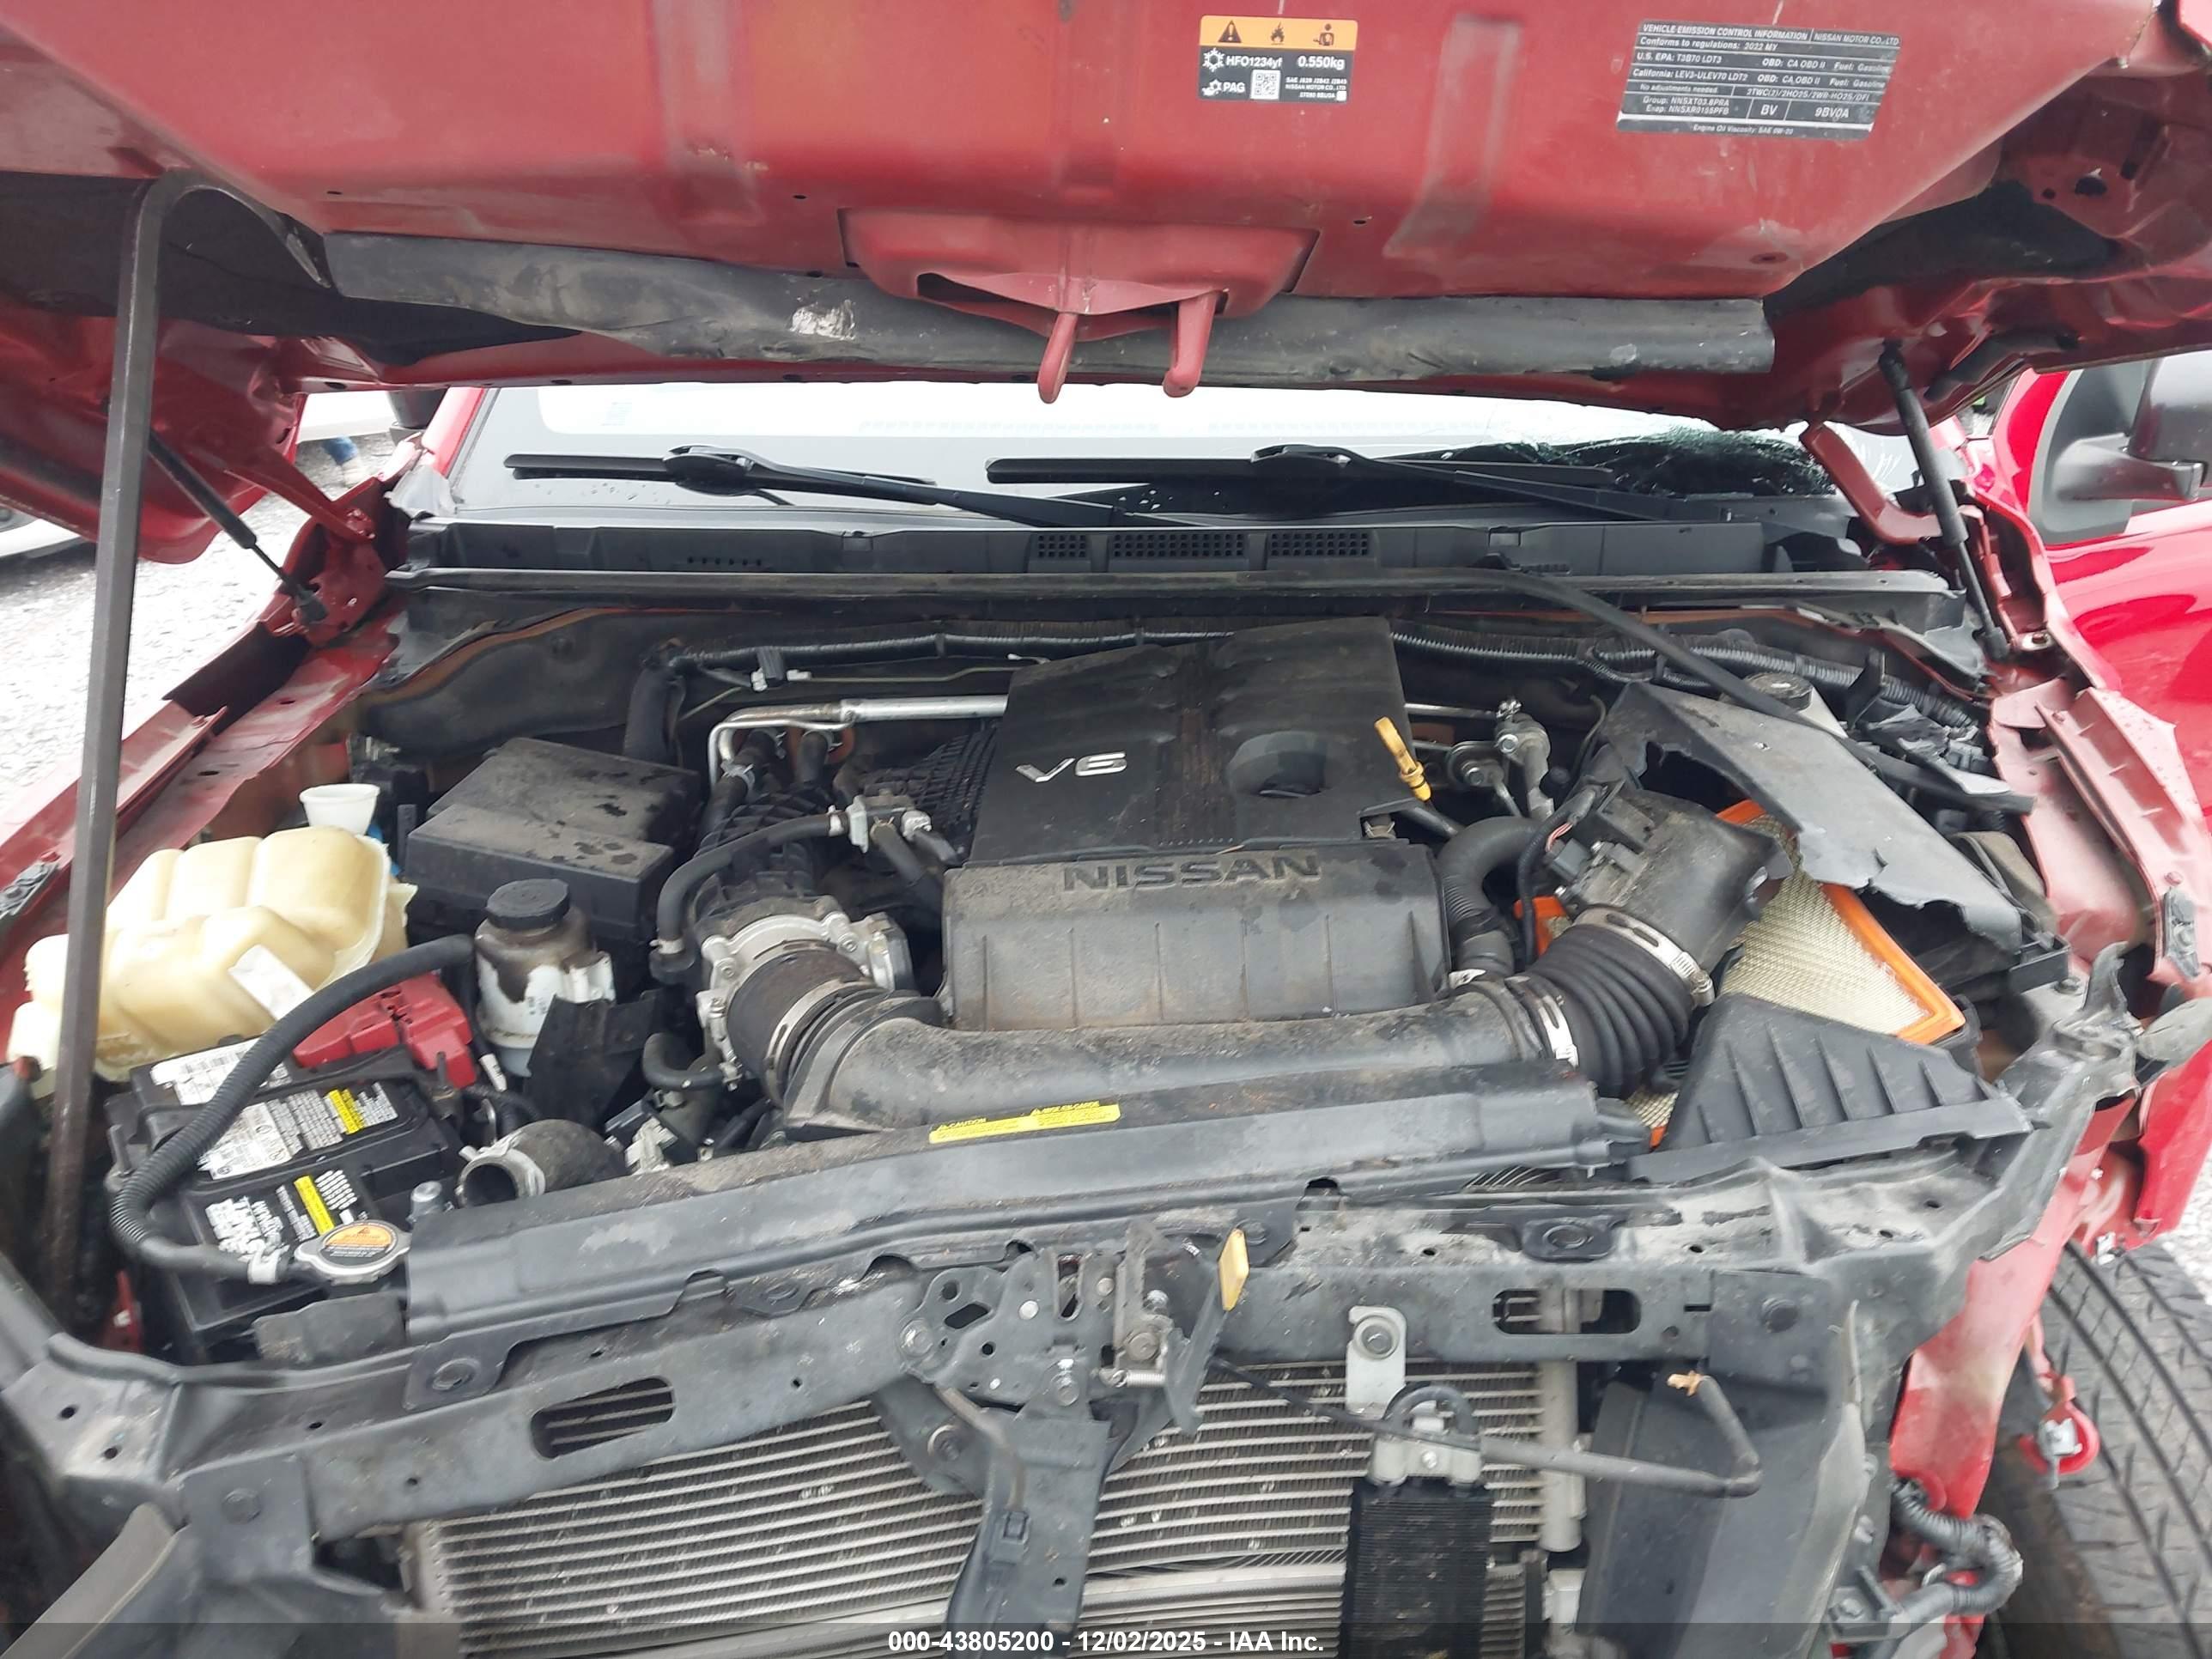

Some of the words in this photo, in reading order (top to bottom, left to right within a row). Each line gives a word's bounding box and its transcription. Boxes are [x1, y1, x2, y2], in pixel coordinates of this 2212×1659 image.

[1643, 24, 1675, 33] VEHICLE
[1677, 25, 1716, 35] EMISSION
[1717, 27, 1753, 37] CONTROL
[1754, 29, 1808, 40] INFORMATION
[1640, 36, 1680, 45] Conforms
[1692, 39, 1741, 49] regulations:
[1744, 42, 1763, 51] 2022
[1814, 33, 1841, 41] NISSAN
[1844, 34, 1869, 44] MOTOR
[1225, 56, 1283, 69] HFO1234yf
[1297, 56, 1345, 70] 0.550kg
[1656, 53, 1674, 62] EPA:
[1676, 54, 1700, 63] T3B70
[1762, 58, 1784, 67] OBD:
[1800, 59, 1818, 69] OBD
[1834, 62, 1854, 70] Fuel:
[1632, 68, 1673, 78] California:
[1674, 70, 1727, 80] LEV3-ULEV70
[1758, 74, 1778, 82] OBD:
[1782, 76, 1793, 84] CA
[1795, 76, 1814, 84] OBD
[1223, 82, 1245, 94] PAG
[1650, 85, 1691, 94] adjustments
[1643, 96, 1668, 105] Group:
[1760, 105, 1778, 115] BV
[1692, 124, 1715, 132] Engine
[1016, 750, 1127, 783] V6
[1064, 855, 1321, 891] NISSAN
